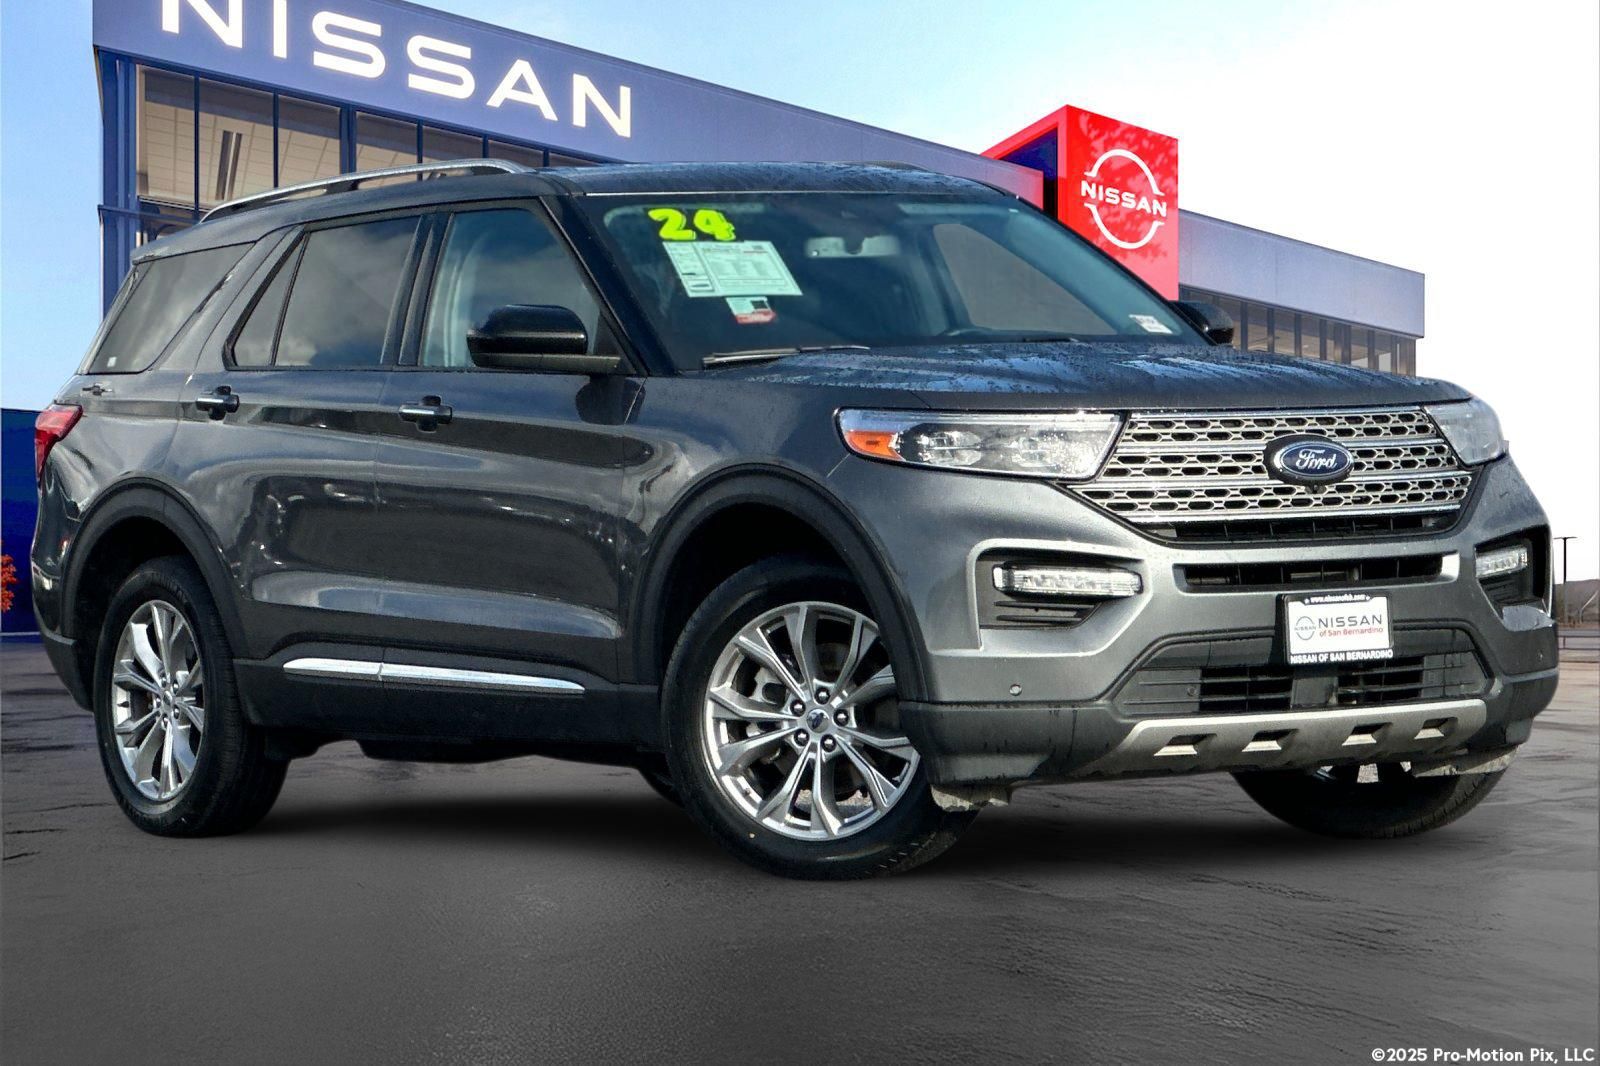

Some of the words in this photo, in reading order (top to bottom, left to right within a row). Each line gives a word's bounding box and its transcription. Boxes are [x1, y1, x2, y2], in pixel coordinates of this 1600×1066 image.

[161, 0, 631, 138] NISSAN
[1081, 180, 1167, 217] NISSAN
[648, 208, 736, 241] 24
[1296, 448, 1338, 469] Ford
[1318, 614, 1382, 628] NISSAN
[1328, 628, 1341, 637] San
[1343, 627, 1384, 636] Bernardino
[1290, 654, 1318, 664] NISSAN
[1319, 653, 1329, 662] OF
[1330, 652, 1345, 662] SAN
[1346, 648, 1394, 661] BERNARDINO
